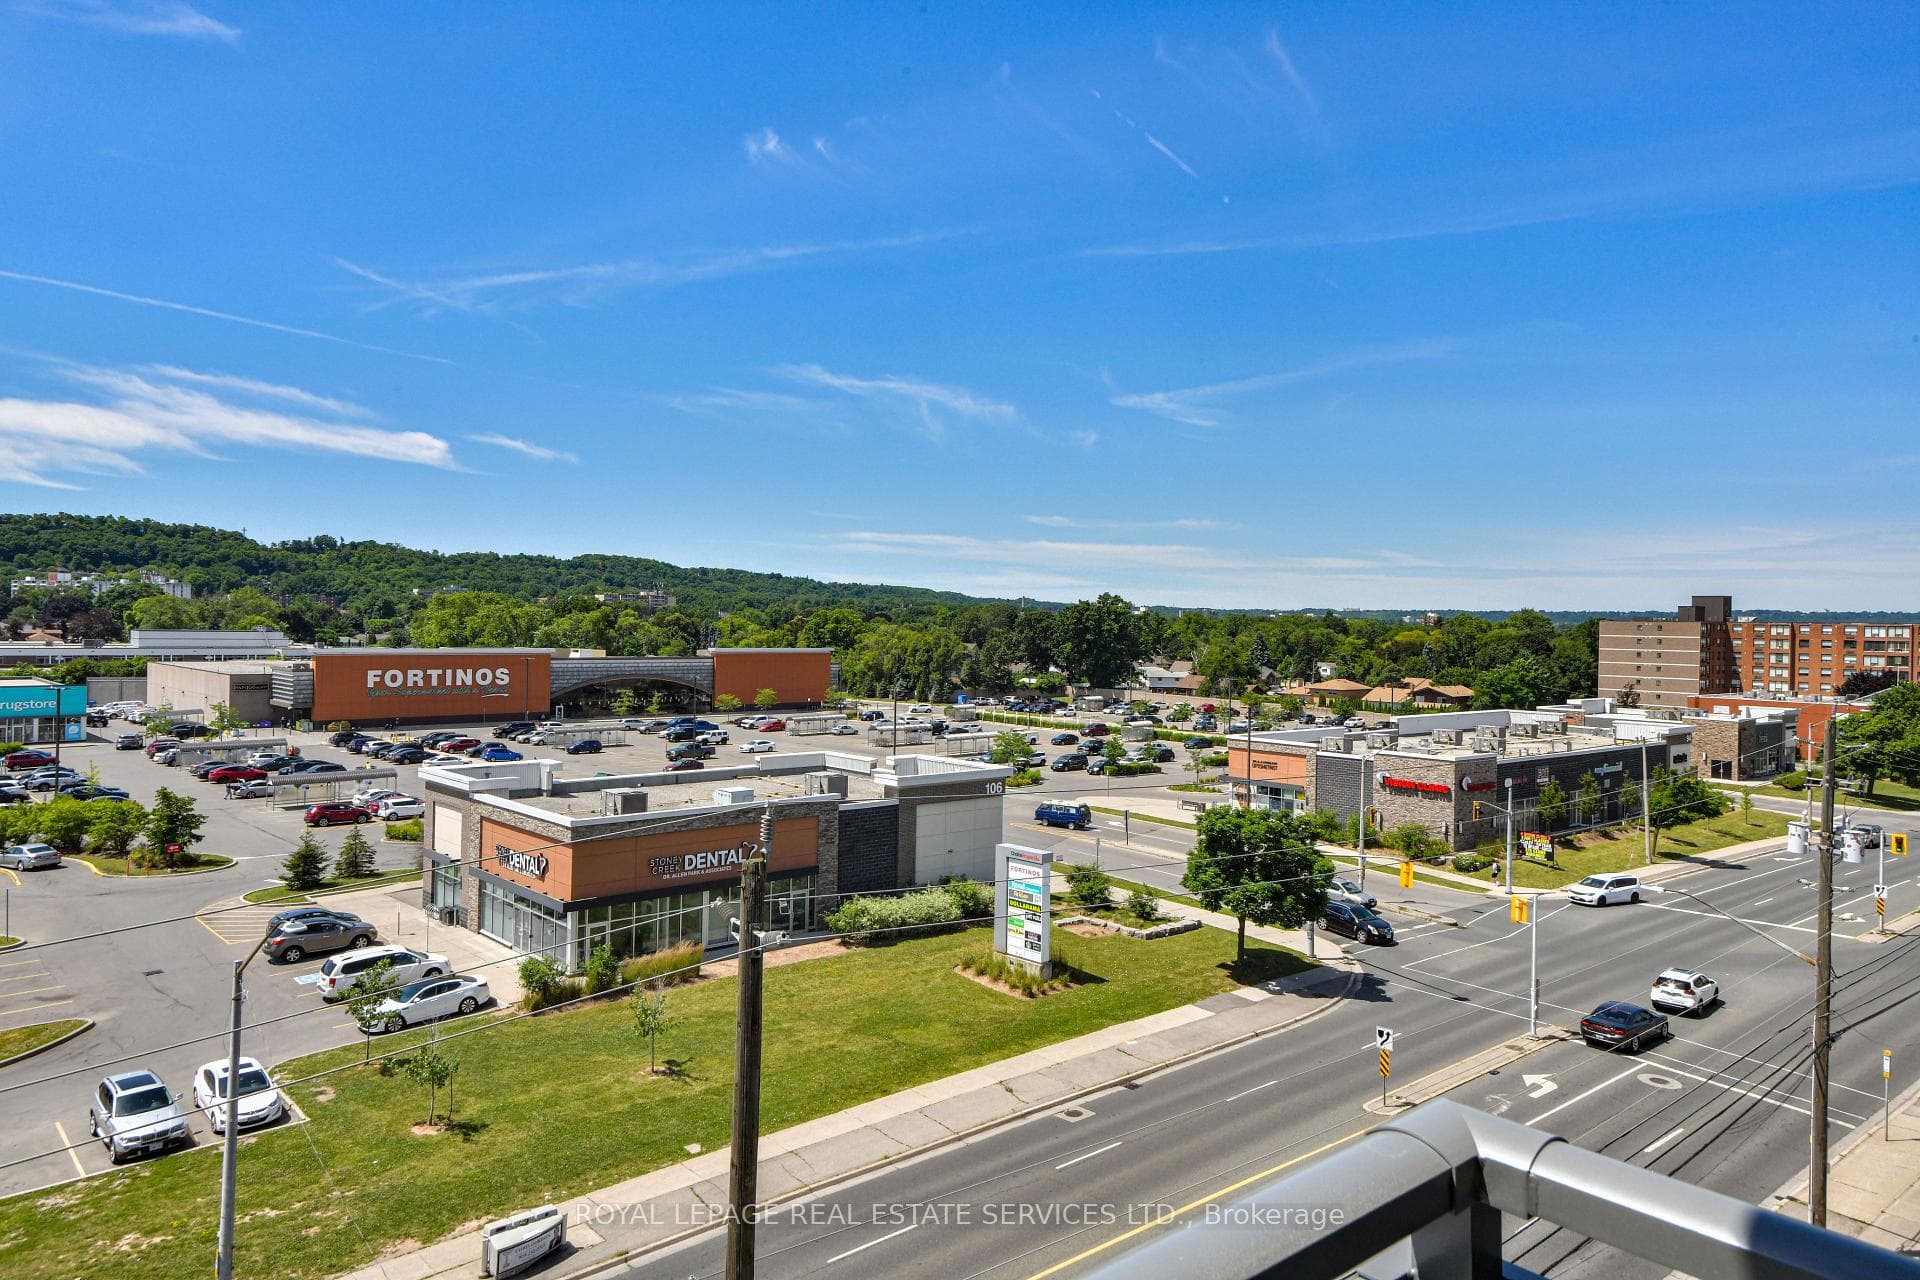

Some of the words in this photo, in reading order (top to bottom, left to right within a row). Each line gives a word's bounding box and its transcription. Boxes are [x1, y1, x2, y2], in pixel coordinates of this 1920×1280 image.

[367, 668, 510, 688] FORTINOS
[0, 700, 57, 711] rugstore
[985, 782, 1003, 794] 106
[509, 850, 540, 875] DENTAL
[650, 855, 682, 867] STONEY
[684, 848, 745, 871] DENTAL
[652, 865, 680, 875] CREEK
[1010, 865, 1040, 877] FORTINOS
[1009, 899, 1041, 912] DOLLARAMA
